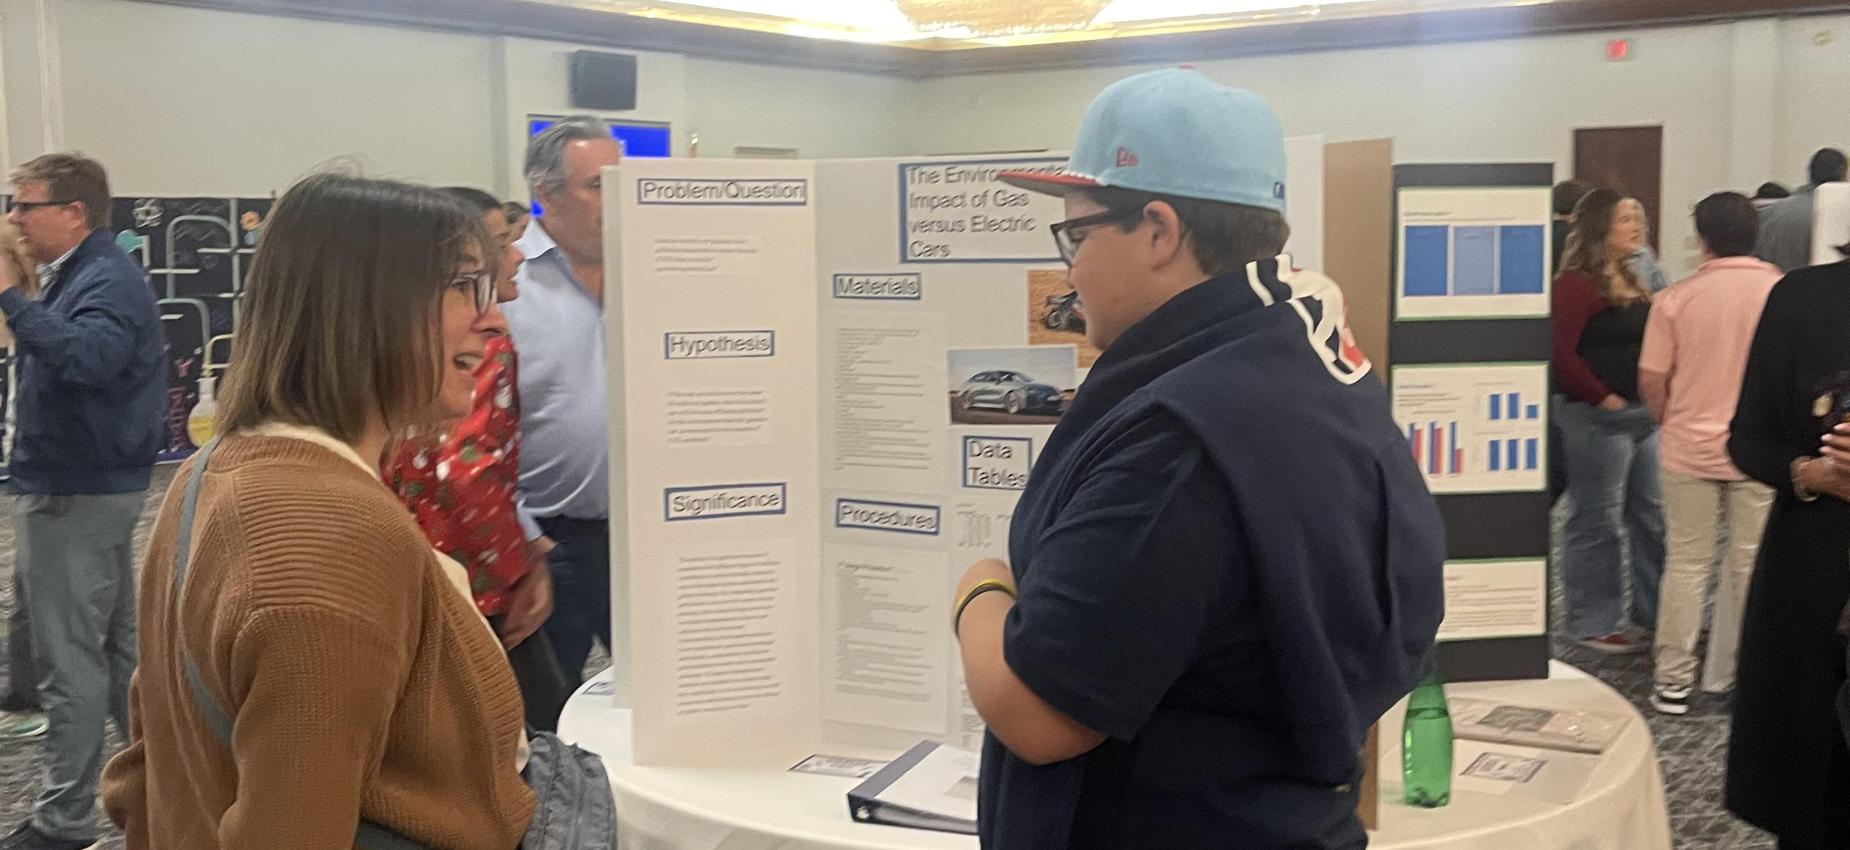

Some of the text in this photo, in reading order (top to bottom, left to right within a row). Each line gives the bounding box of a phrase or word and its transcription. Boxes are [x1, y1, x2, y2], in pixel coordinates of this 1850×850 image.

[908, 165, 940, 184] The
[643, 181, 806, 200] Problem/Question
[909, 188, 1031, 212] Impact of Gas
[910, 214, 1037, 234] versus Electric
[909, 239, 952, 258] Cars
[836, 276, 919, 297] Materials
[670, 334, 771, 358] Hypothesis
[968, 439, 1013, 459] Data
[967, 466, 1027, 487] Tables
[672, 489, 782, 516] Significance
[839, 504, 937, 531] Procedures
